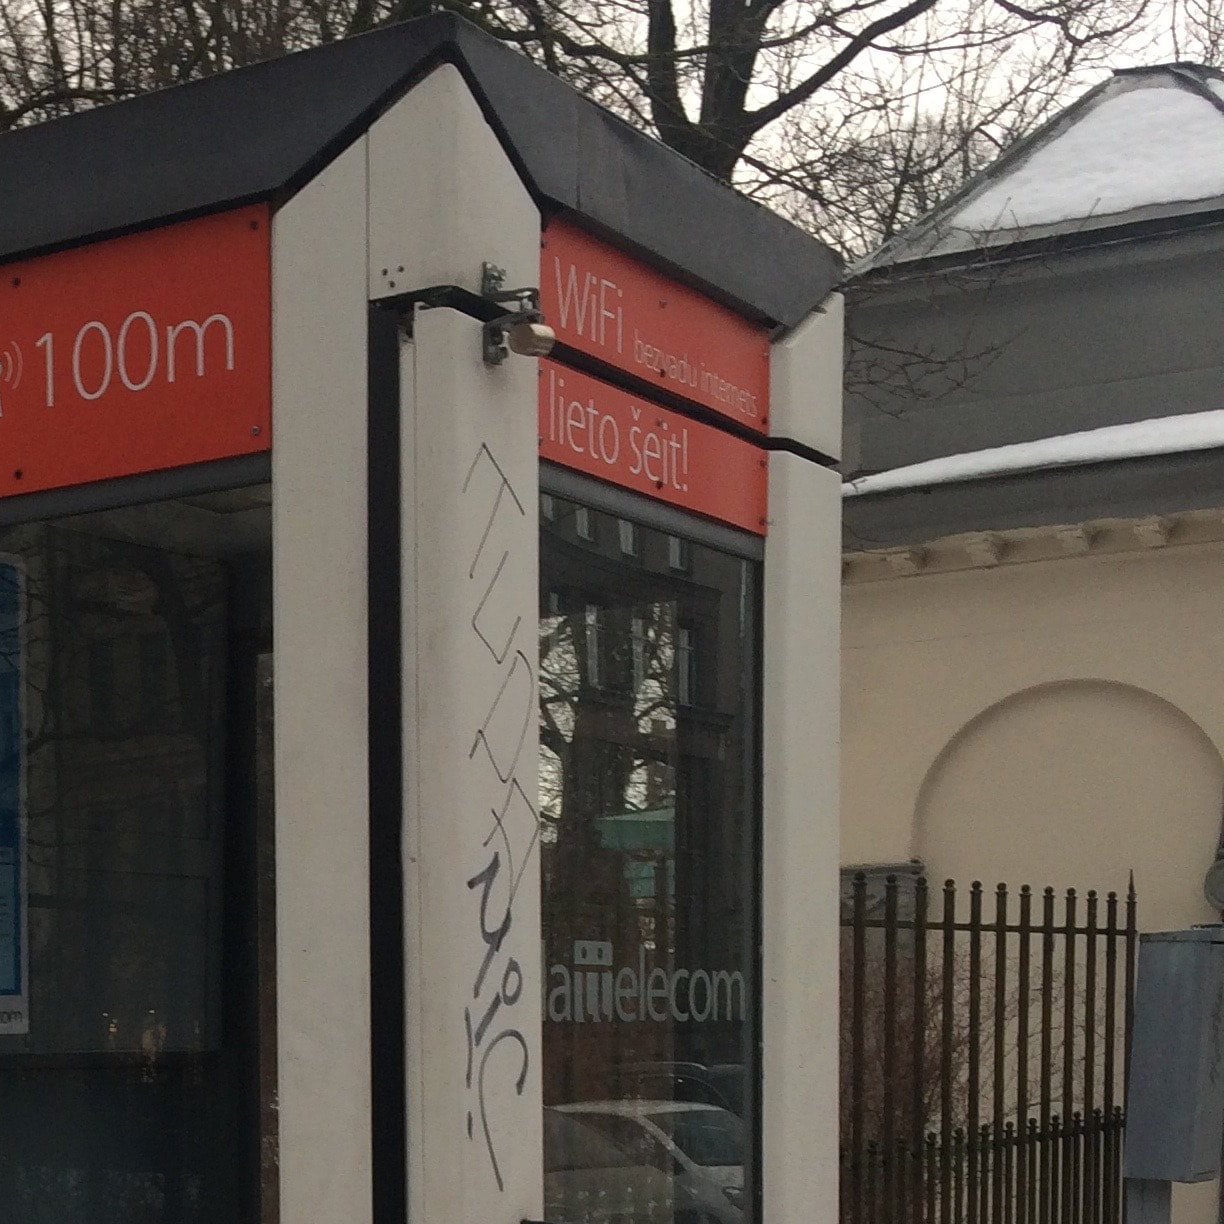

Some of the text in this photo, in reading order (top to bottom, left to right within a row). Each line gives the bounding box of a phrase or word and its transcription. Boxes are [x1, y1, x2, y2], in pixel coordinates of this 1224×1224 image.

[554, 256, 623, 353] WiFi
[35, 311, 235, 407] 100m
[549, 369, 620, 465] lieto
